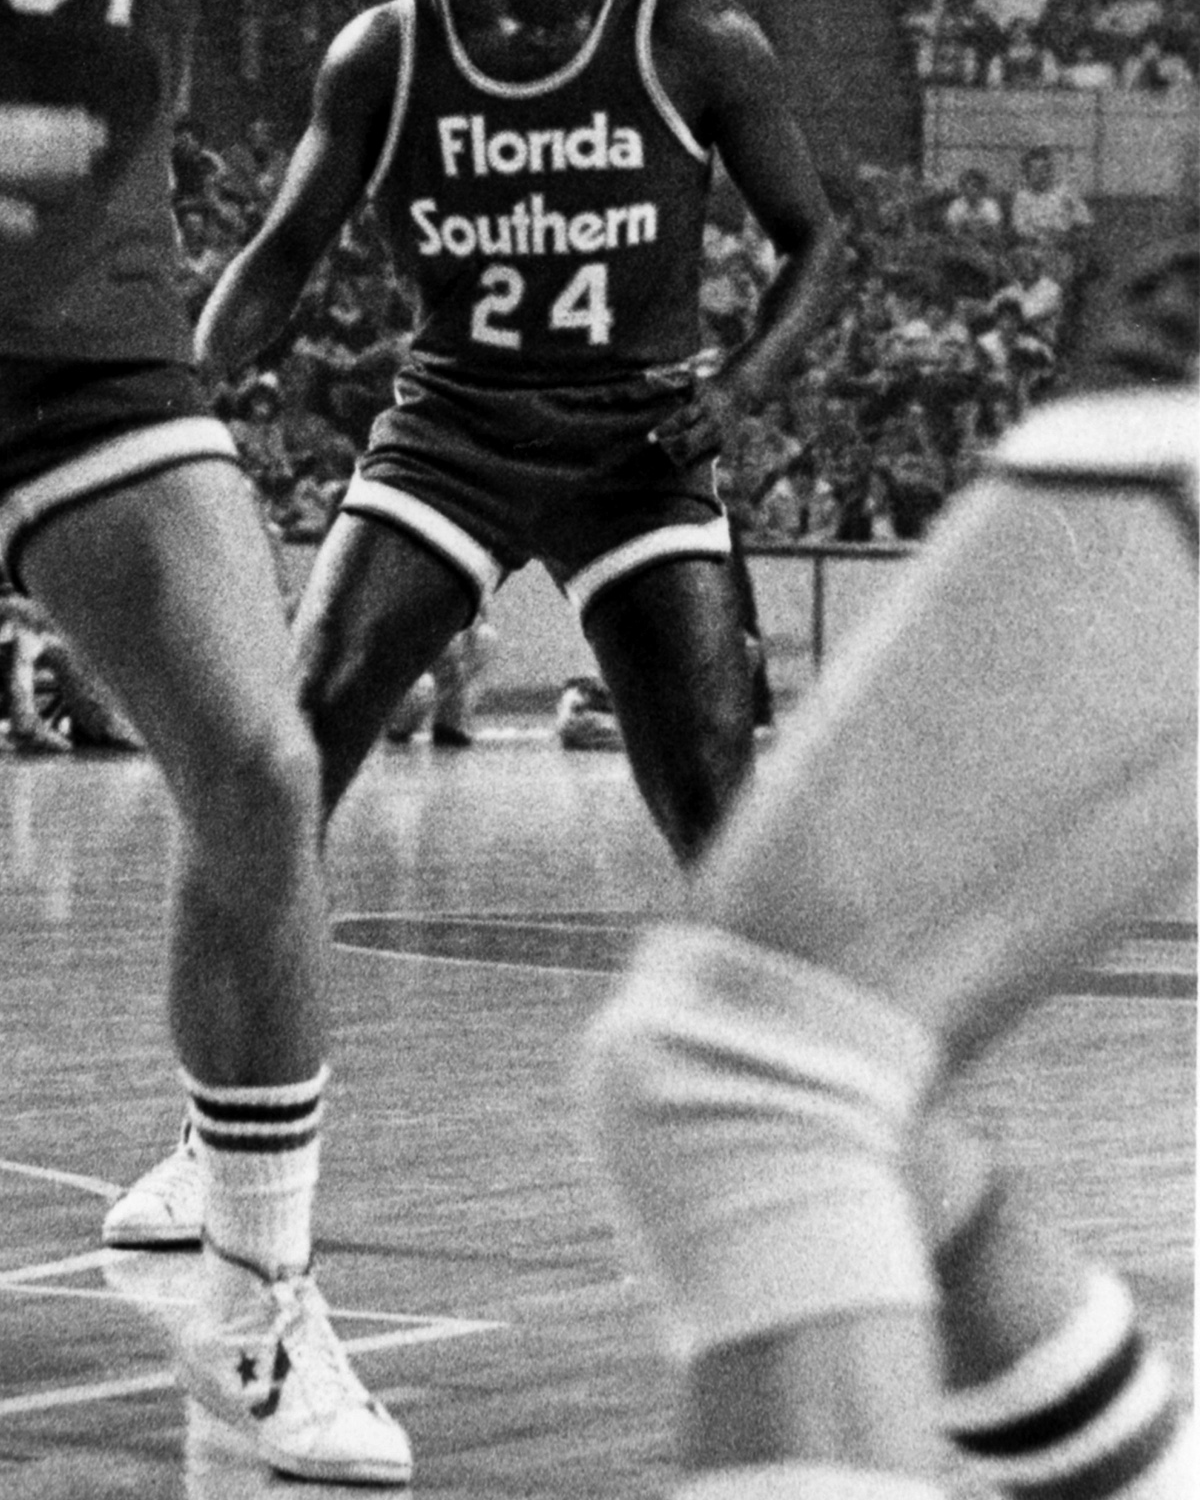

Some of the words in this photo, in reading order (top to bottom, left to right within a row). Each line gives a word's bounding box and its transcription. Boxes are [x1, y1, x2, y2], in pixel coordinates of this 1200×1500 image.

[437, 111, 644, 176] Florida
[410, 192, 658, 257] Southern
[470, 262, 613, 350] 24
